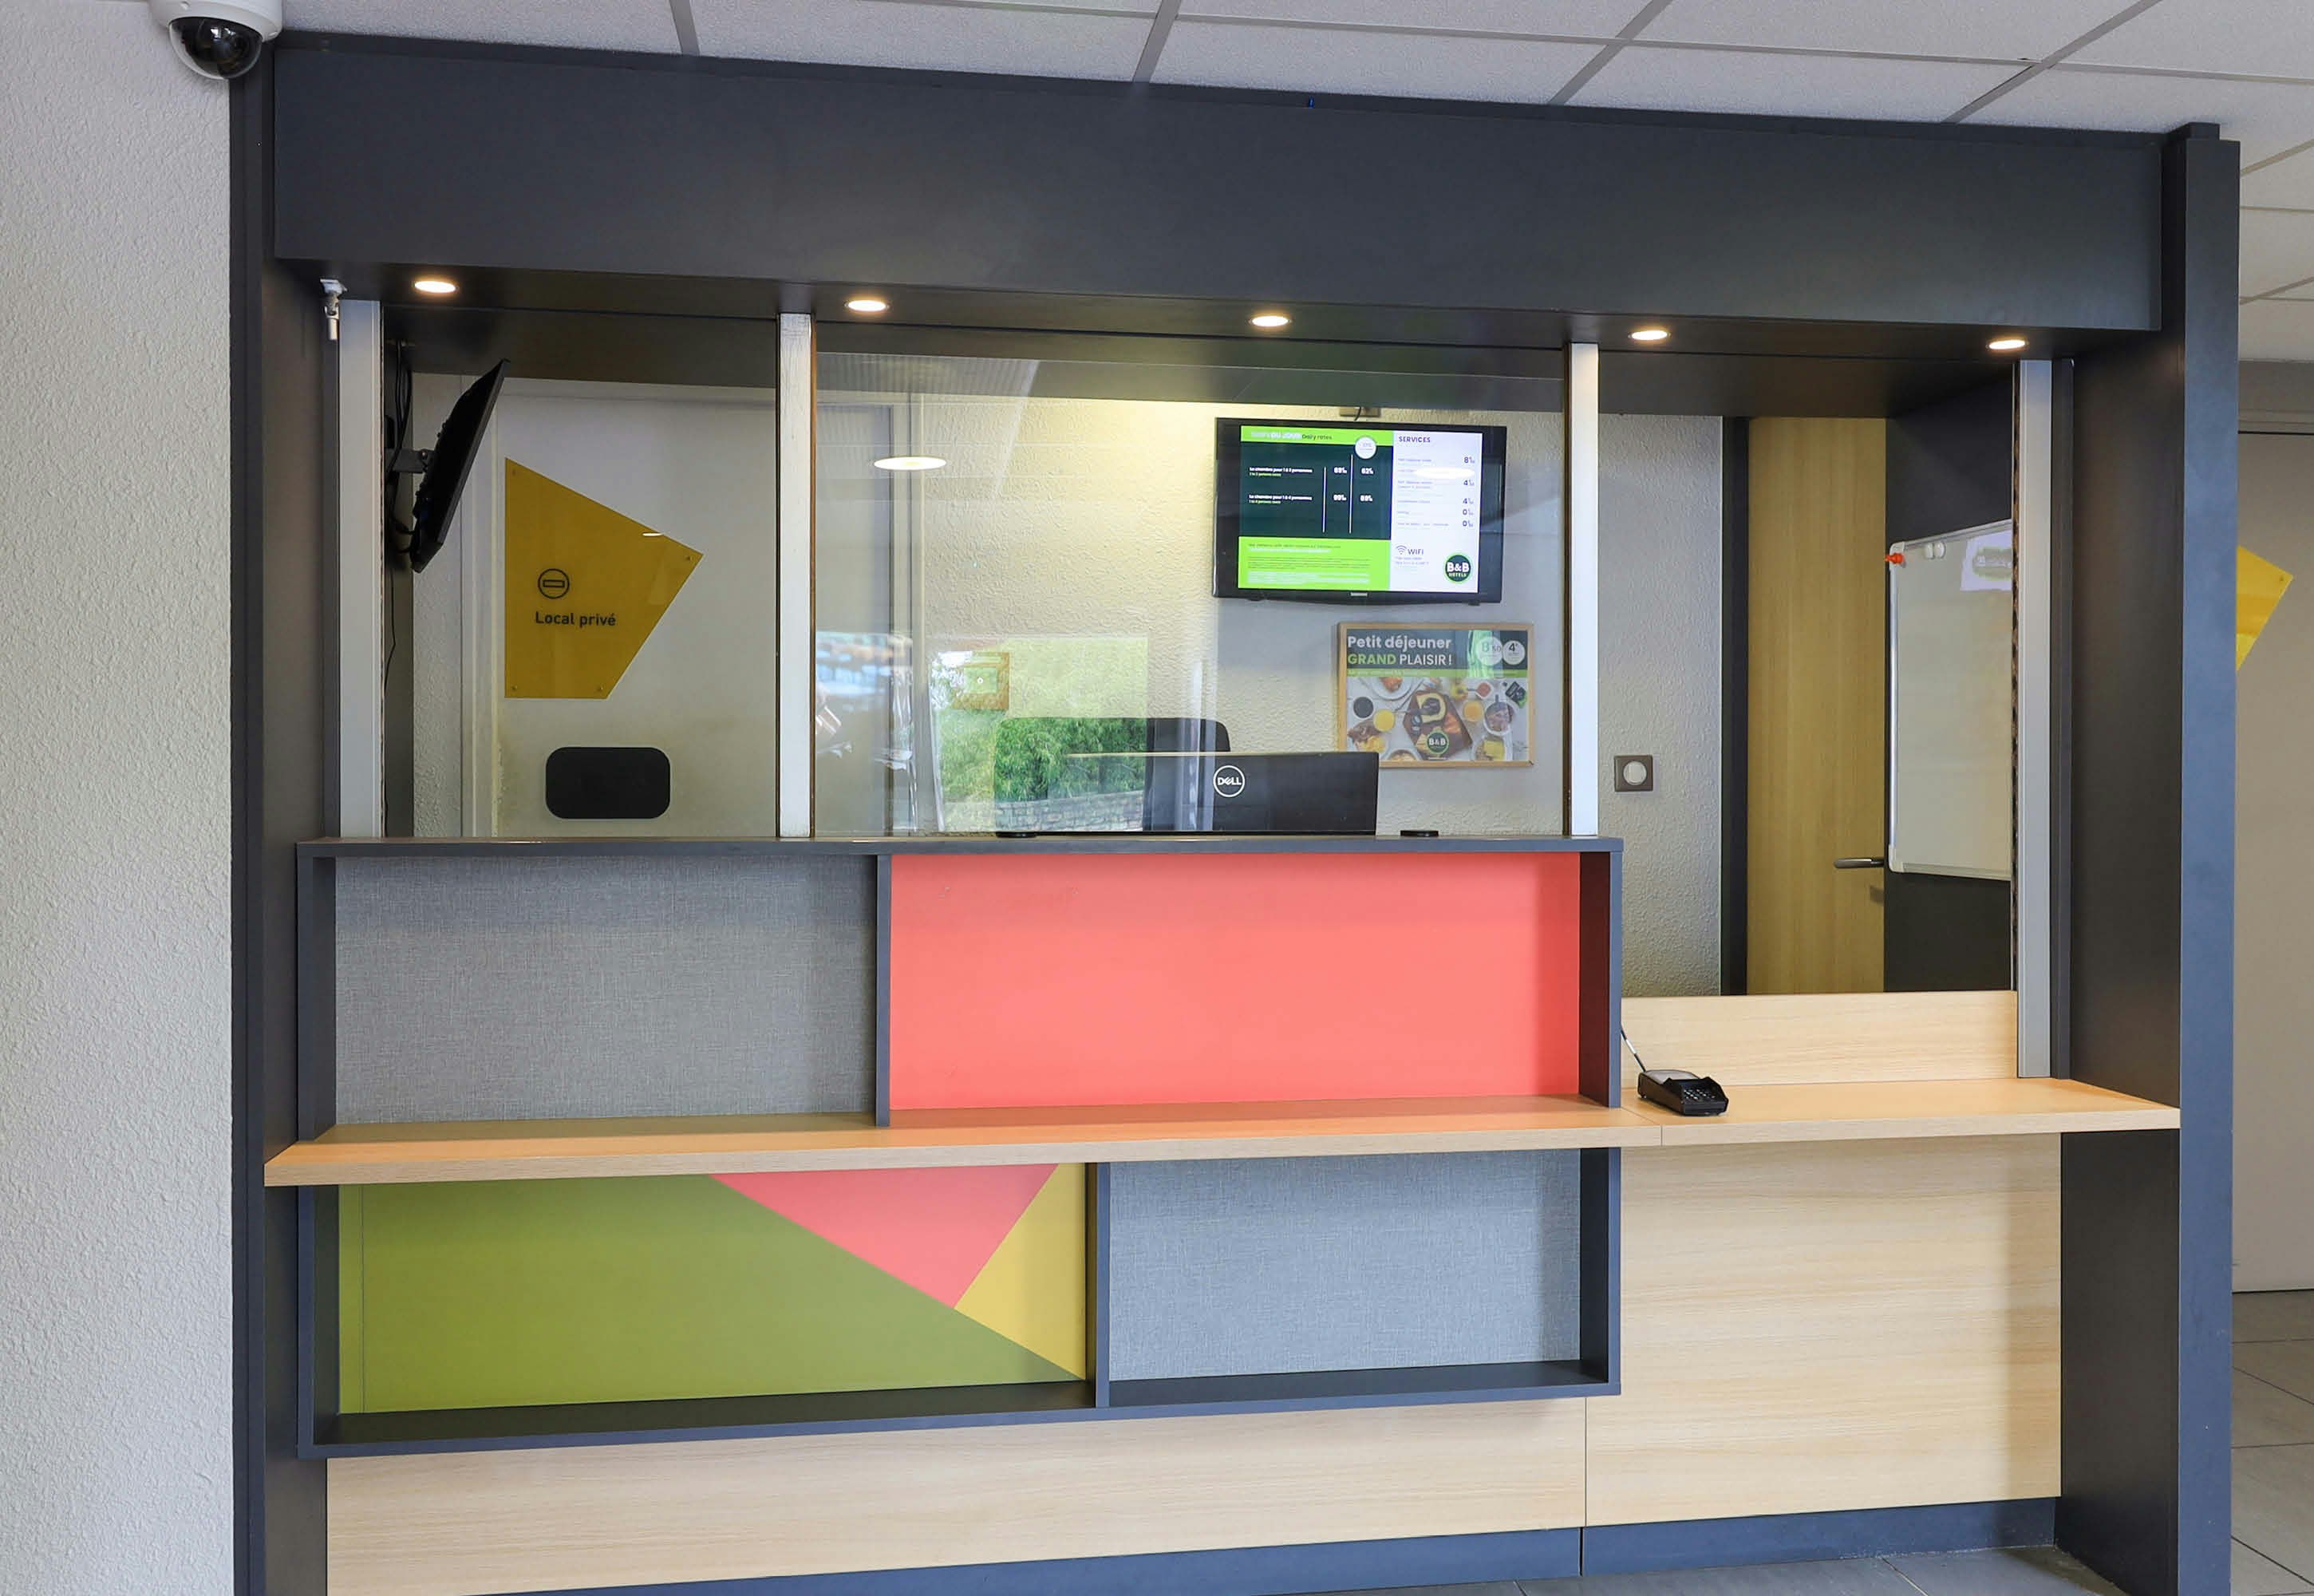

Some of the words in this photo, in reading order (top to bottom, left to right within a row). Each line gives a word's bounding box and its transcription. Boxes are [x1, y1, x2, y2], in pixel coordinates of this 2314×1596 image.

[1447, 562, 1470, 573] B&B
[535, 610, 575, 626] Local
[579, 612, 617, 629] privé
[1347, 634, 1382, 649] Petit
[1384, 634, 1451, 653] déjeuner
[1347, 654, 1396, 665] GRAND
[1399, 654, 1447, 666] PLAISIR
[1428, 737, 1446, 746] B&B
[1217, 776, 1242, 786] DELL
